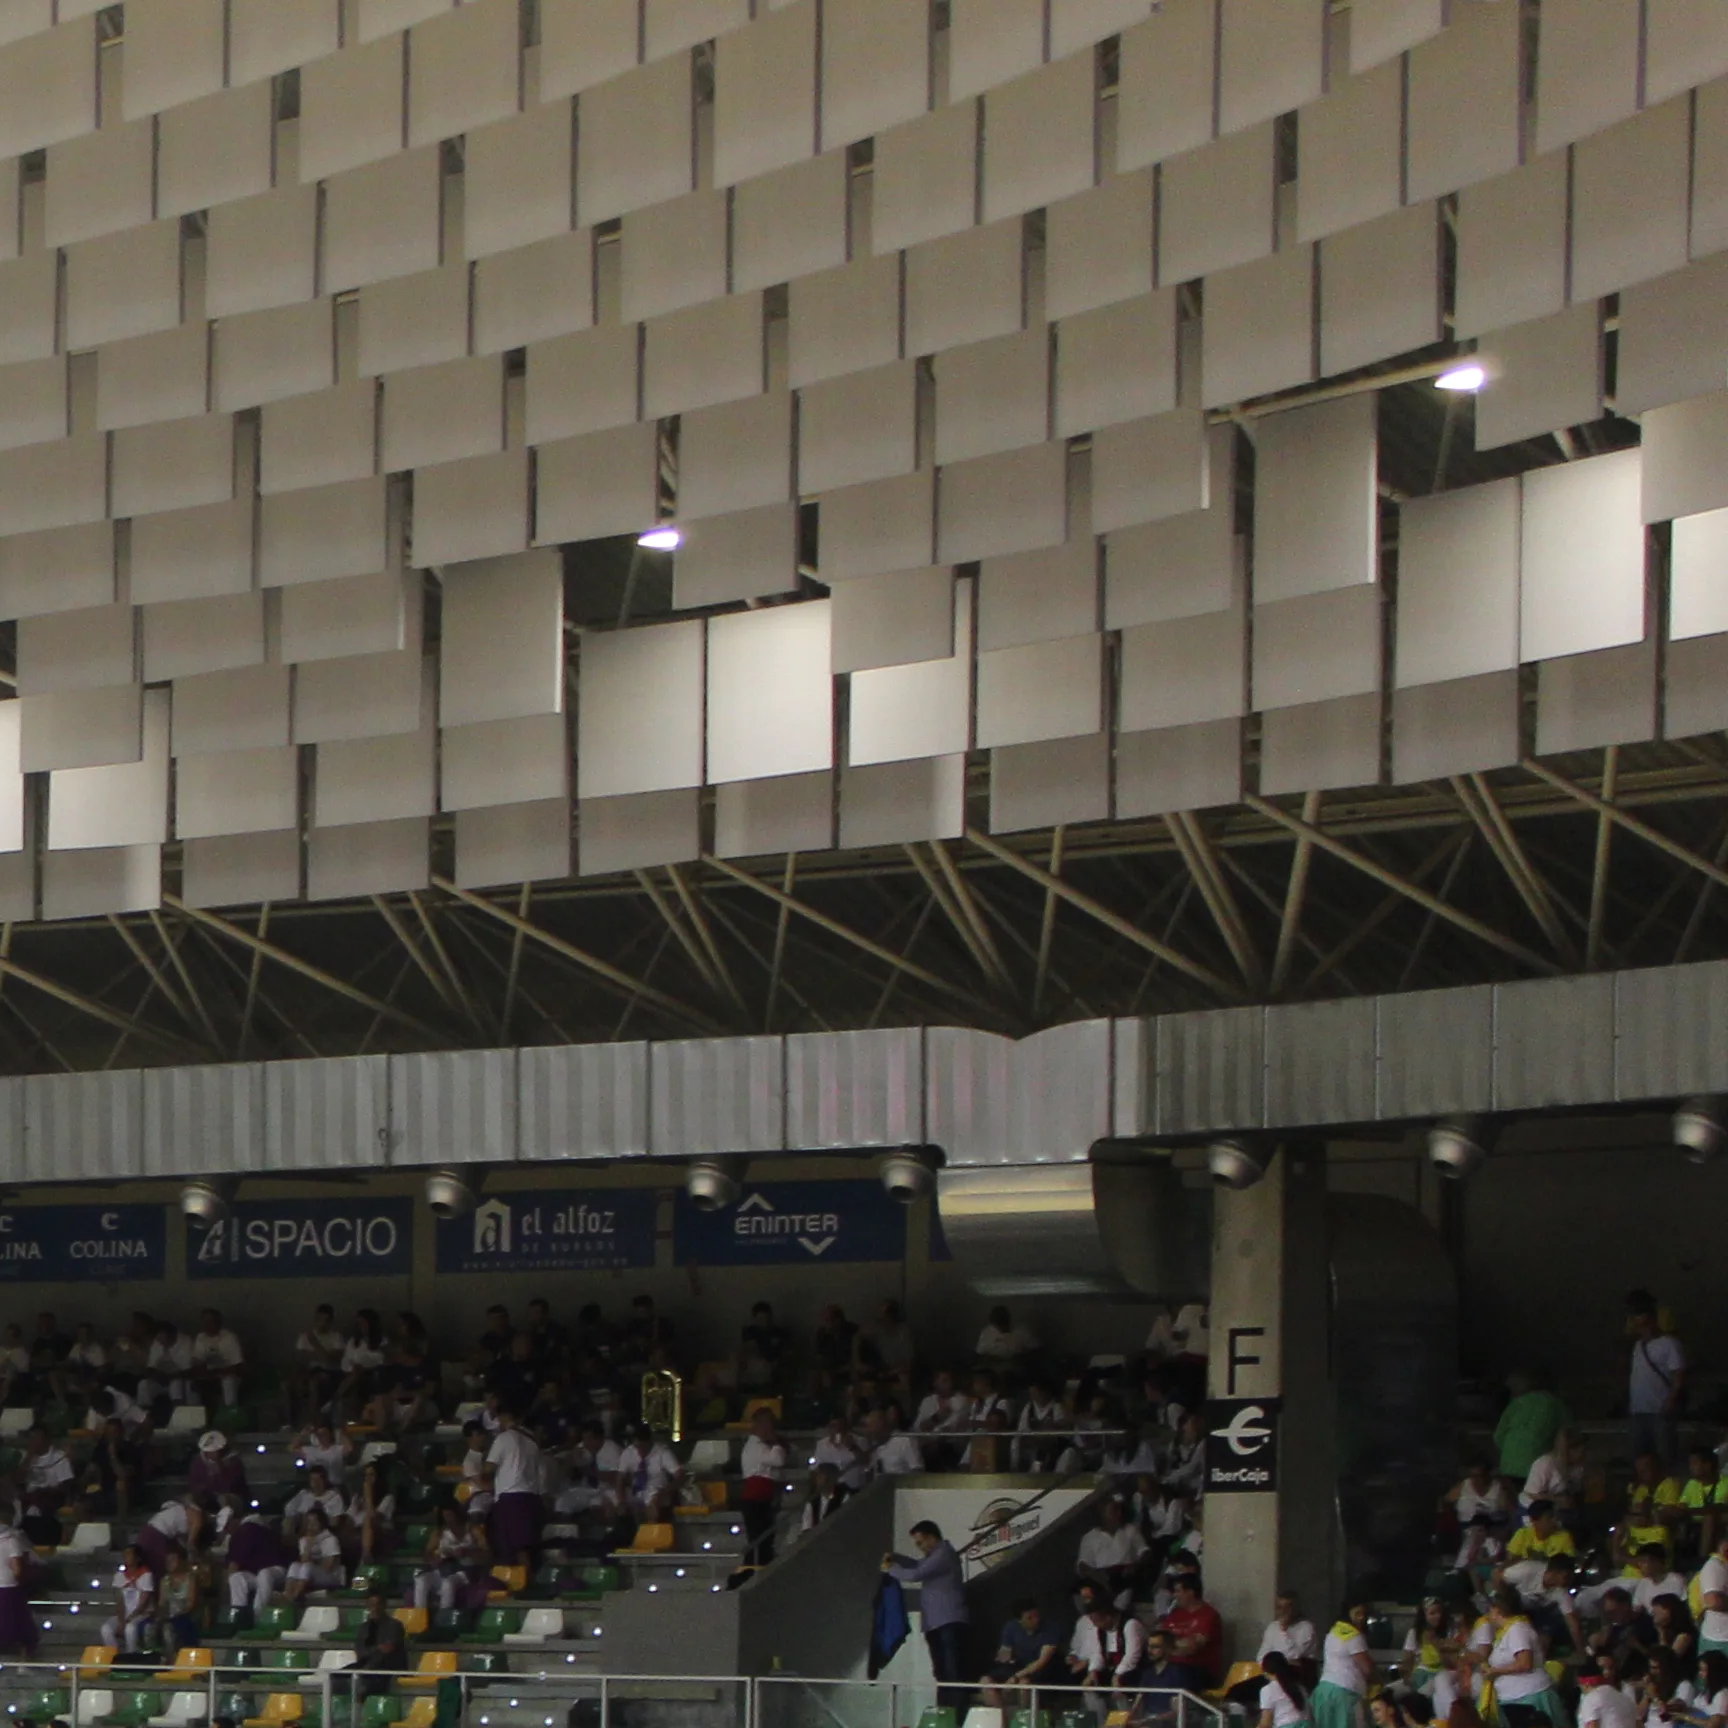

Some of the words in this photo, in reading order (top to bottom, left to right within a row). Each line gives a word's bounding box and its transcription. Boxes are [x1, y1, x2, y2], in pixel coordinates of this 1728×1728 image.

[522, 1207, 543, 1236] el
[553, 1204, 615, 1235] alfoz
[734, 1213, 839, 1235] ENINTER
[69, 1239, 149, 1260] COLINA
[1228, 1331, 1264, 1395] F
[1210, 1466, 1271, 1486] iberCaja
